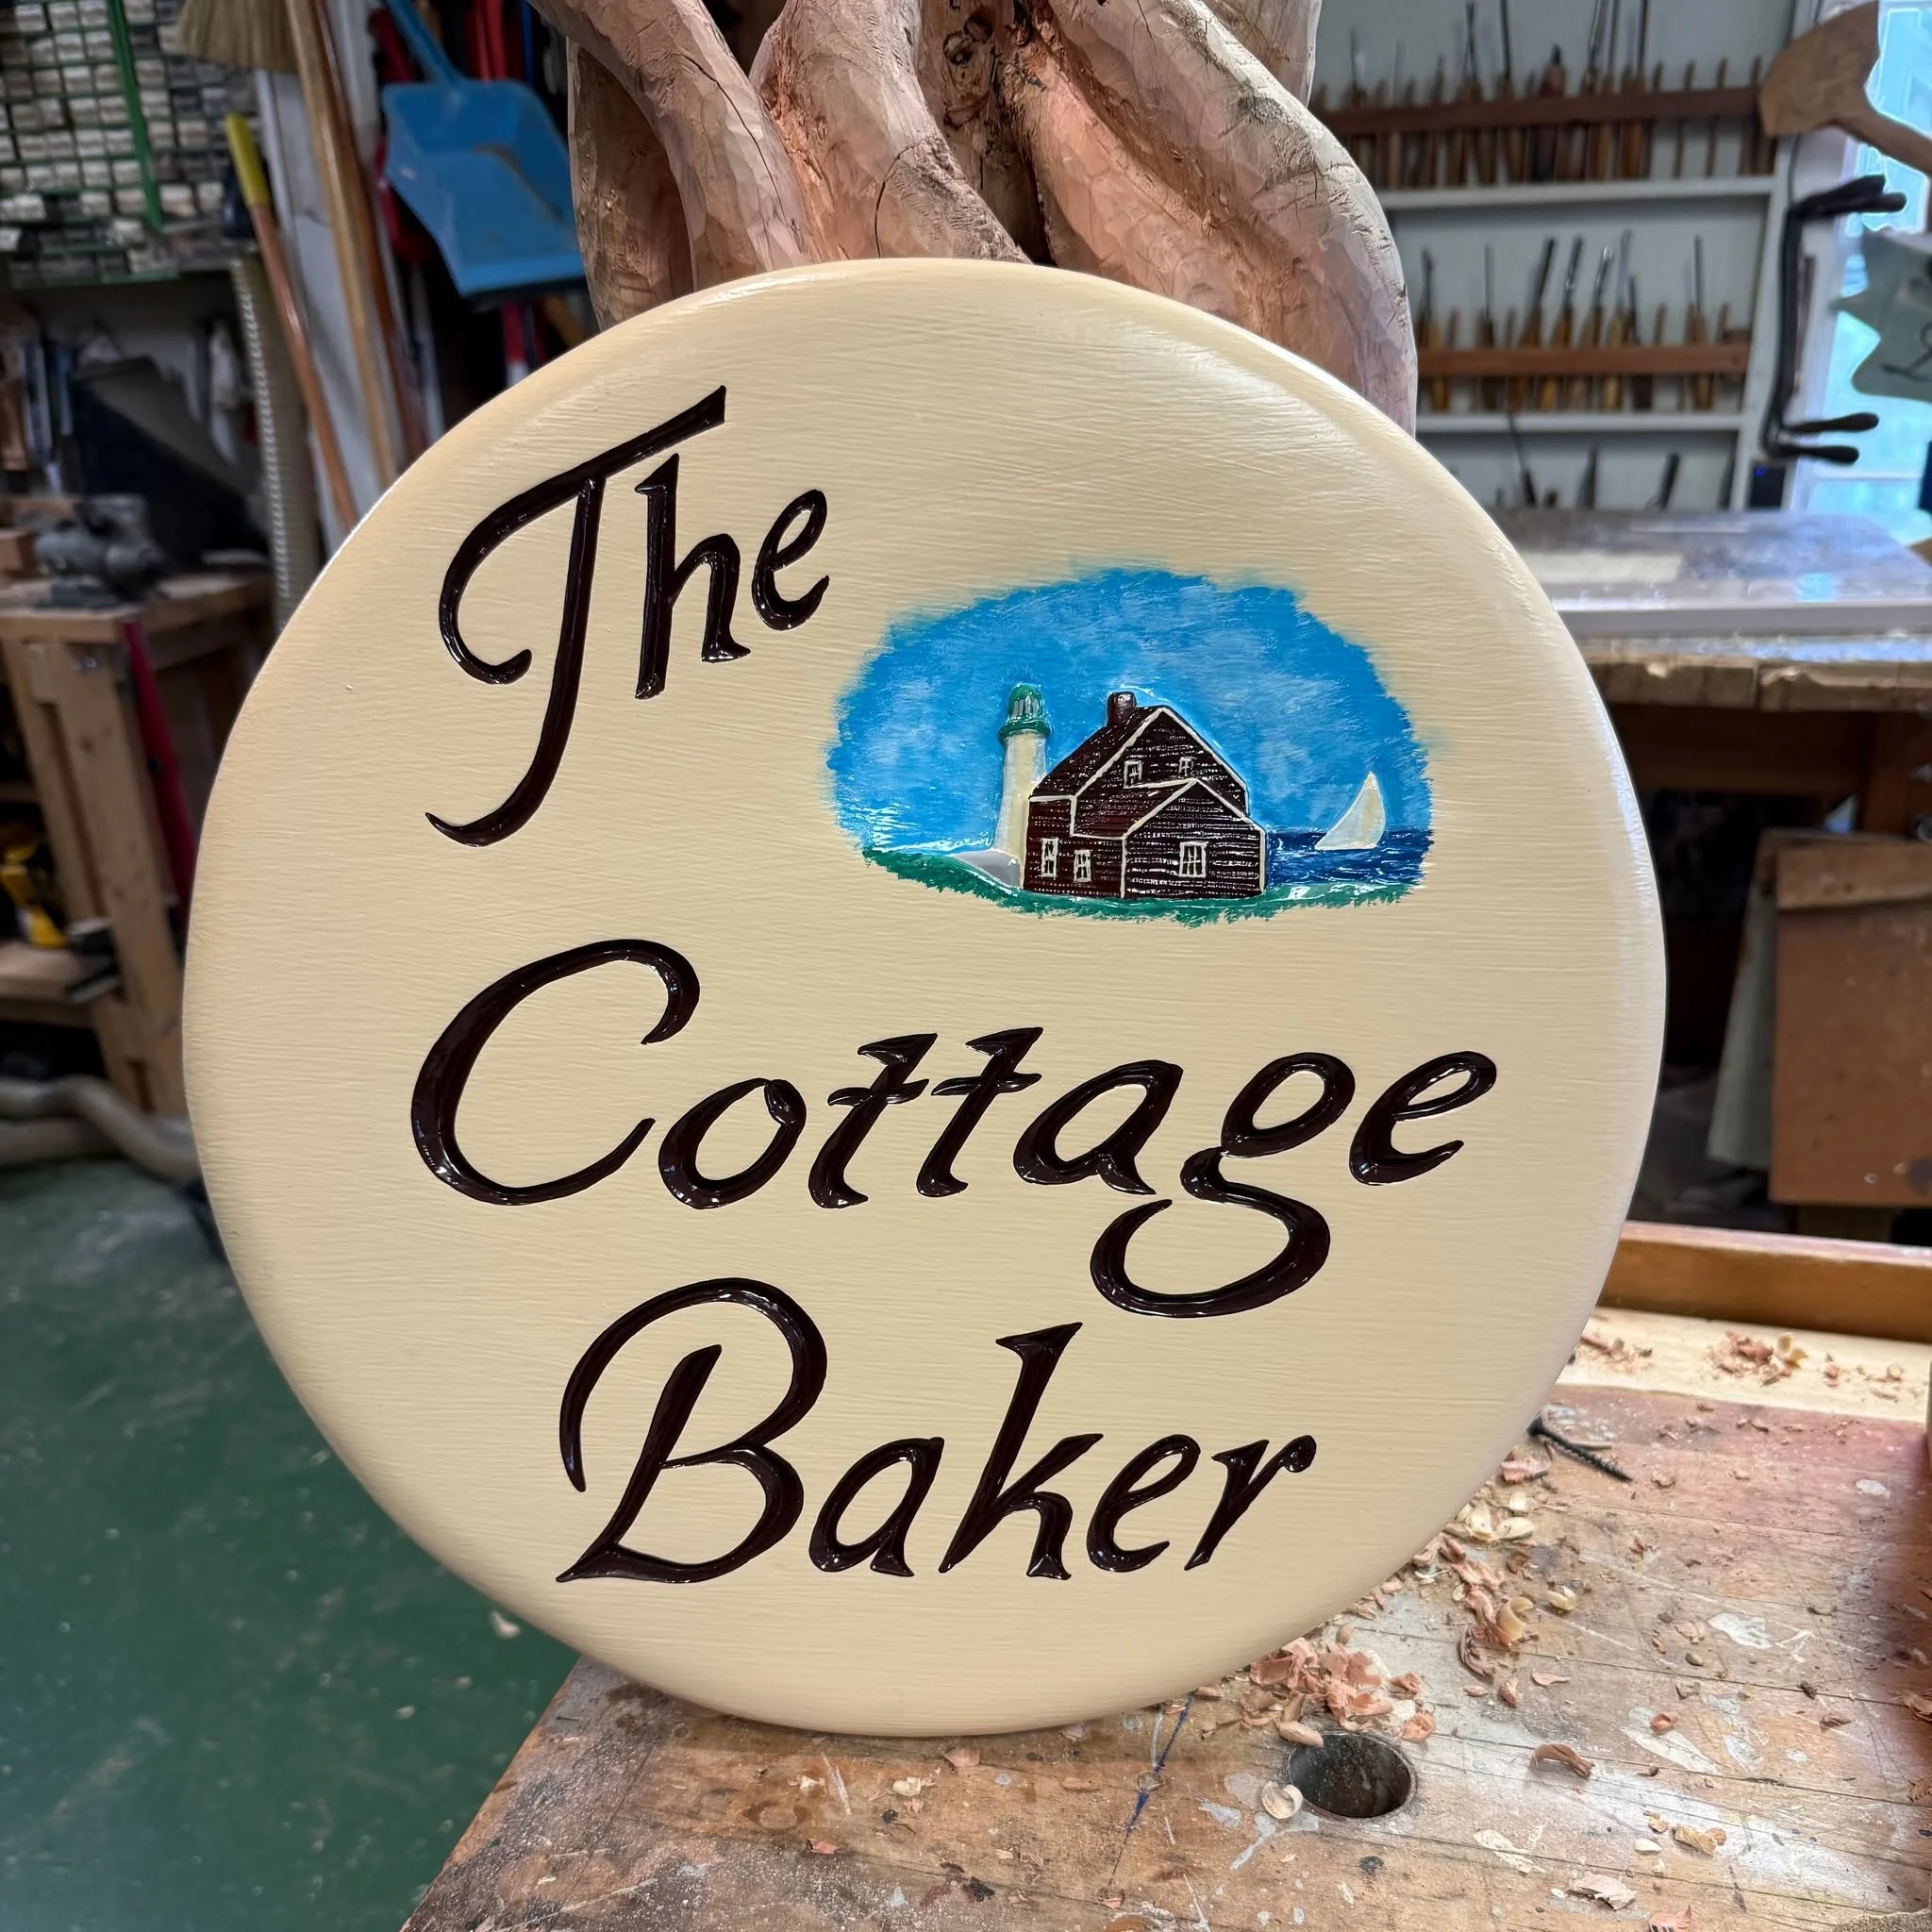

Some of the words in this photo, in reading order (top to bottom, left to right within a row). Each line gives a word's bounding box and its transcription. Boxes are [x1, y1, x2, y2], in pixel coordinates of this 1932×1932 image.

[425, 384, 831, 847] The
[410, 938, 1497, 1319] Cottage
[555, 1276, 1318, 1585] Baker
